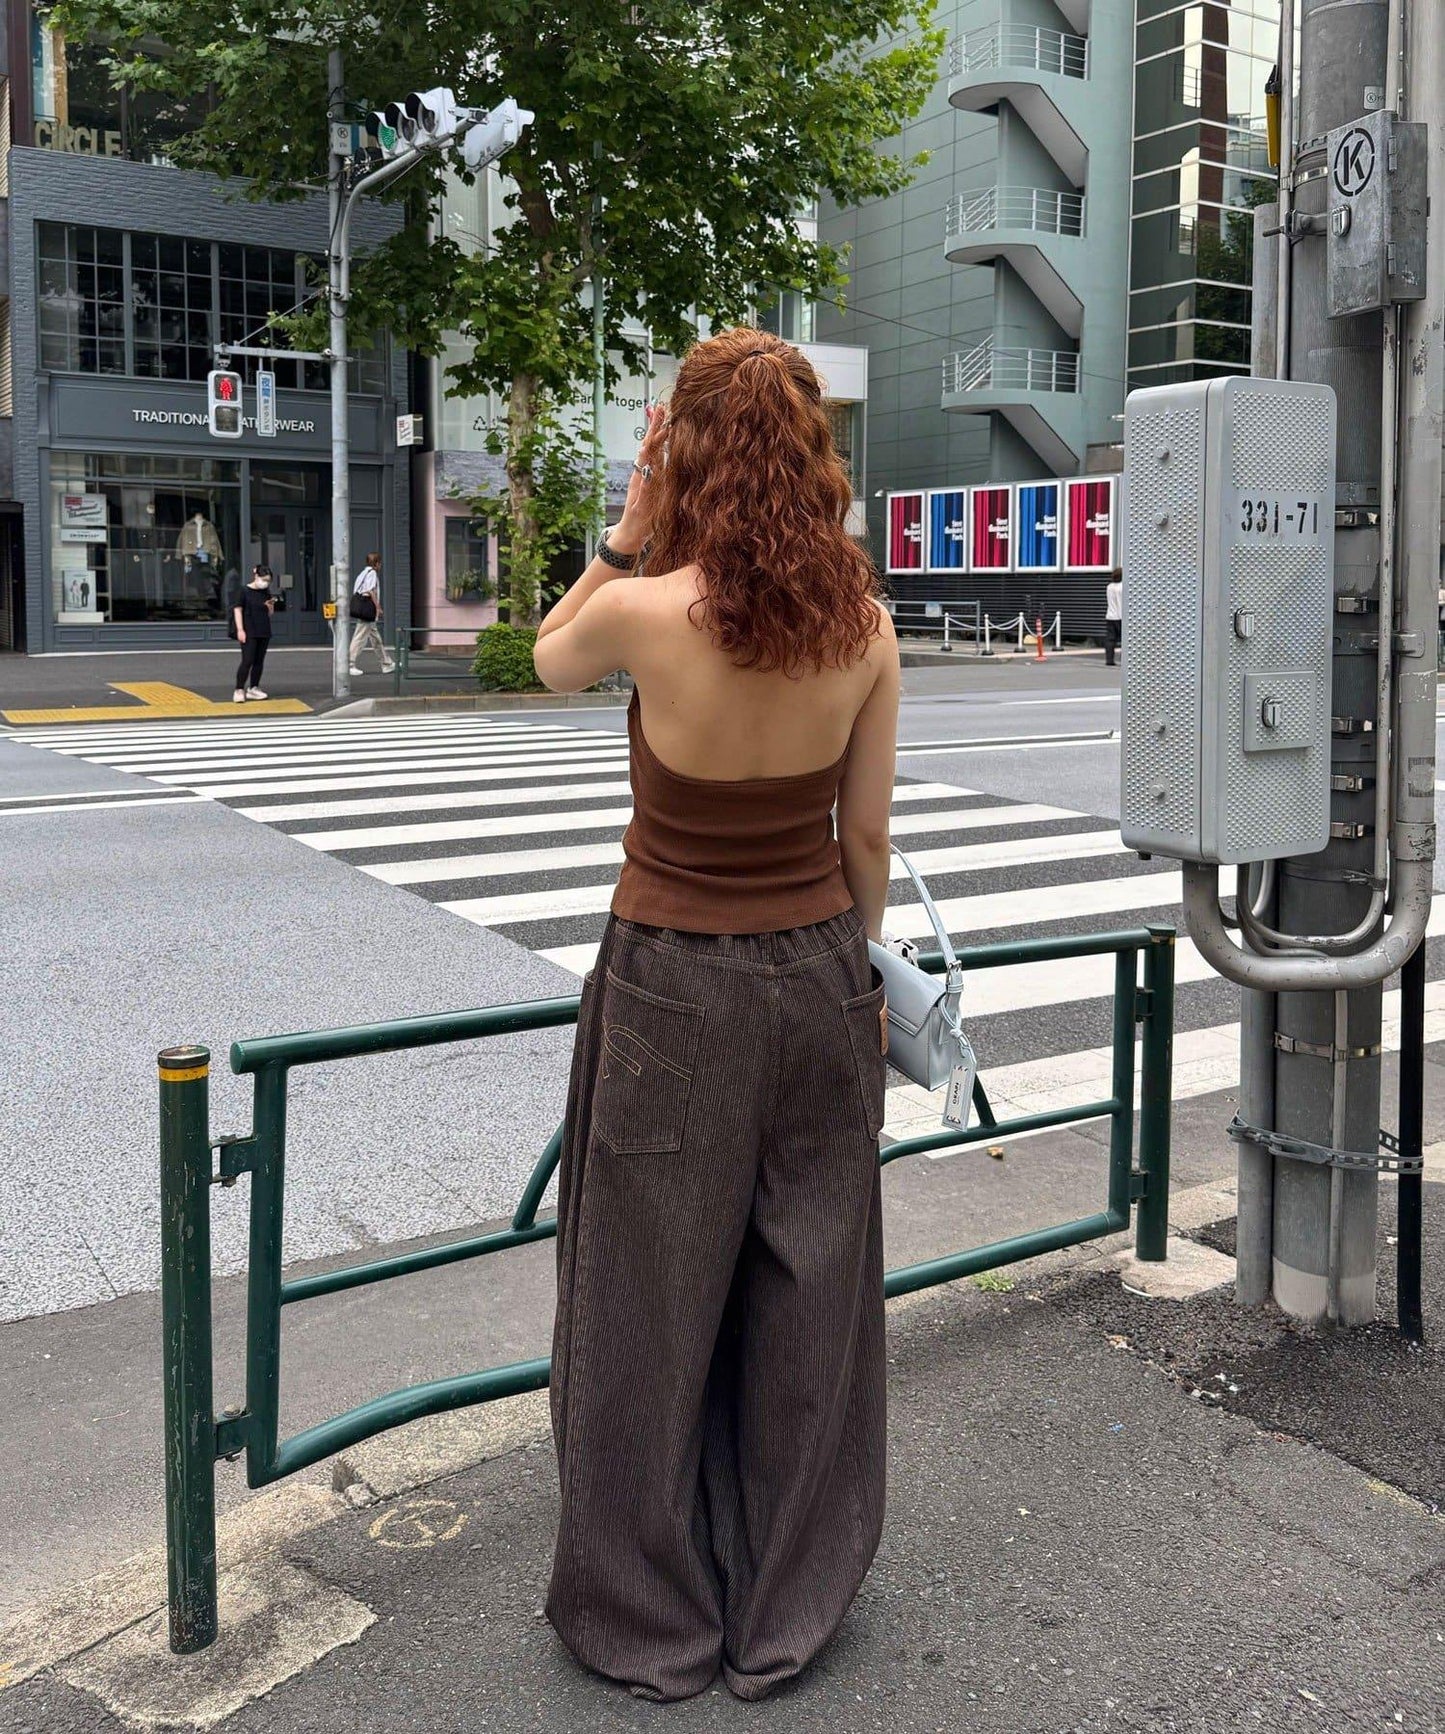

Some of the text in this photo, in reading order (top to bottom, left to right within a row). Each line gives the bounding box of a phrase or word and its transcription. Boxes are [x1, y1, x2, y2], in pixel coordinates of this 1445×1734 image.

[616, 396, 648, 411] toget
[133, 409, 209, 425] TRADITIONA
[1241, 499, 1318, 534] 331-71
